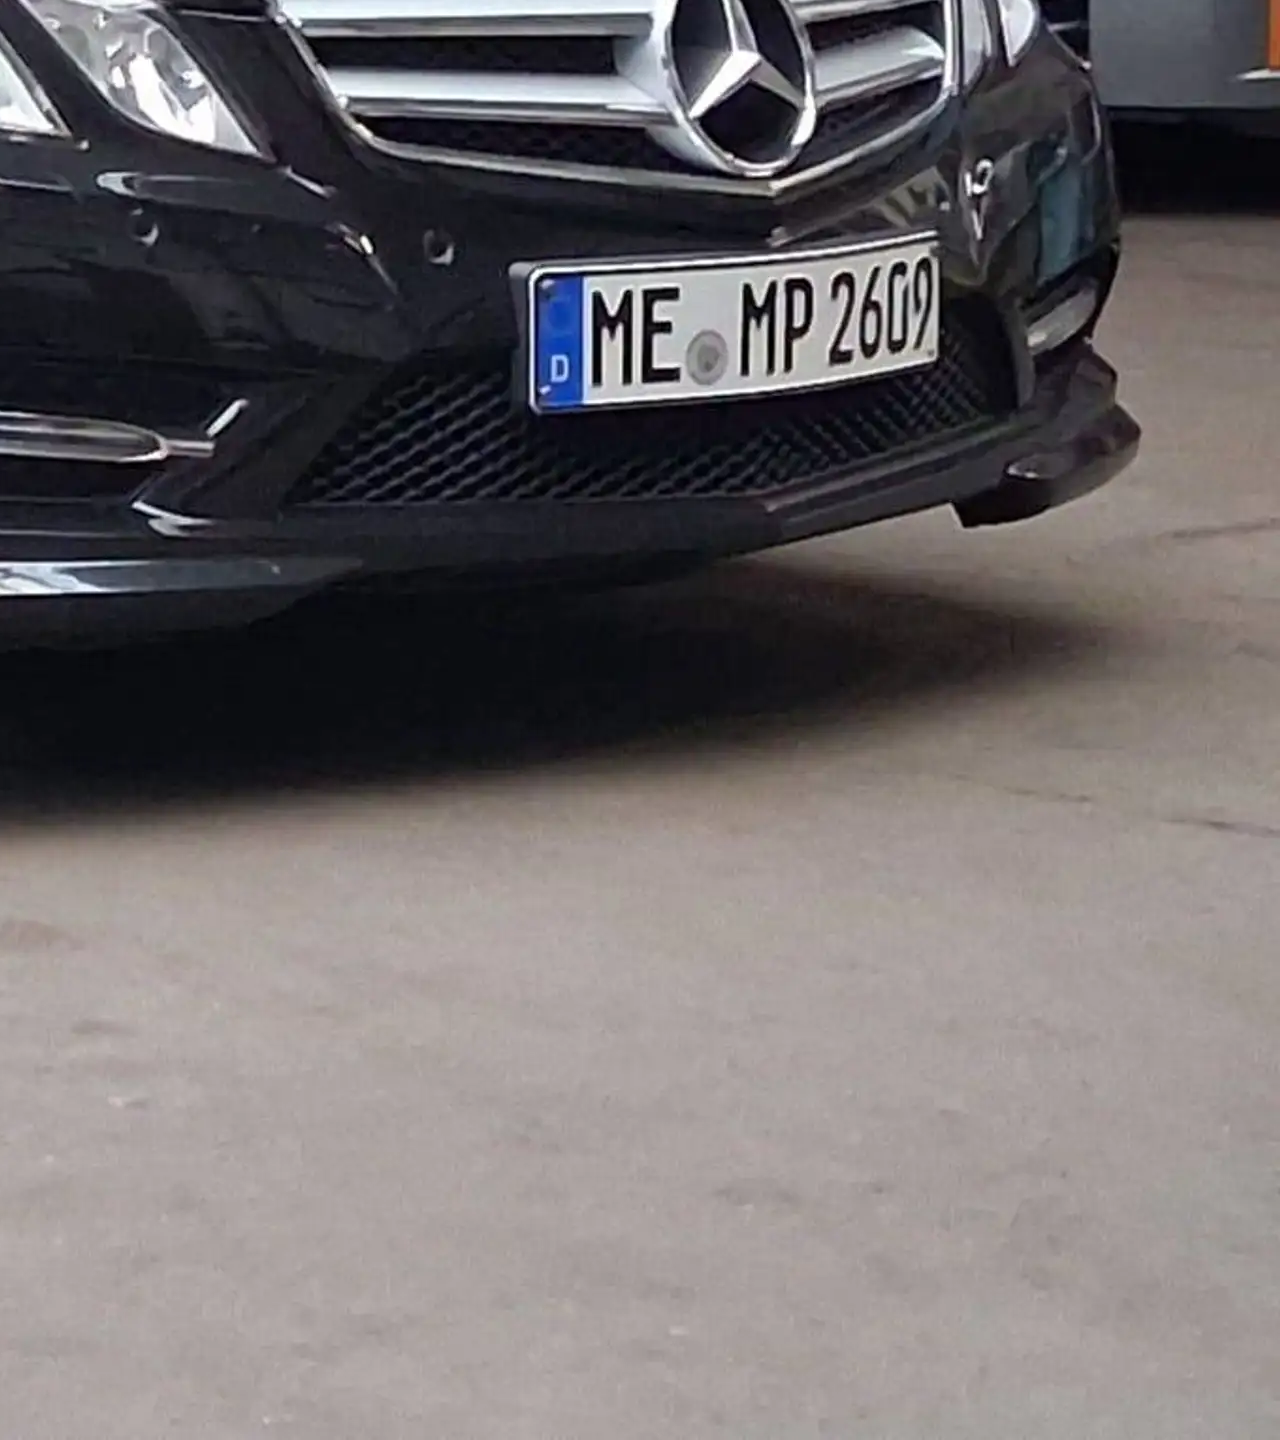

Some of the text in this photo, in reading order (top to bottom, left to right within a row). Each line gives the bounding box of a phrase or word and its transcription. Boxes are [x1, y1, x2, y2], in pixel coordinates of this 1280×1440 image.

[591, 257, 934, 386] ME MP 2609
[551, 355, 569, 383] D
